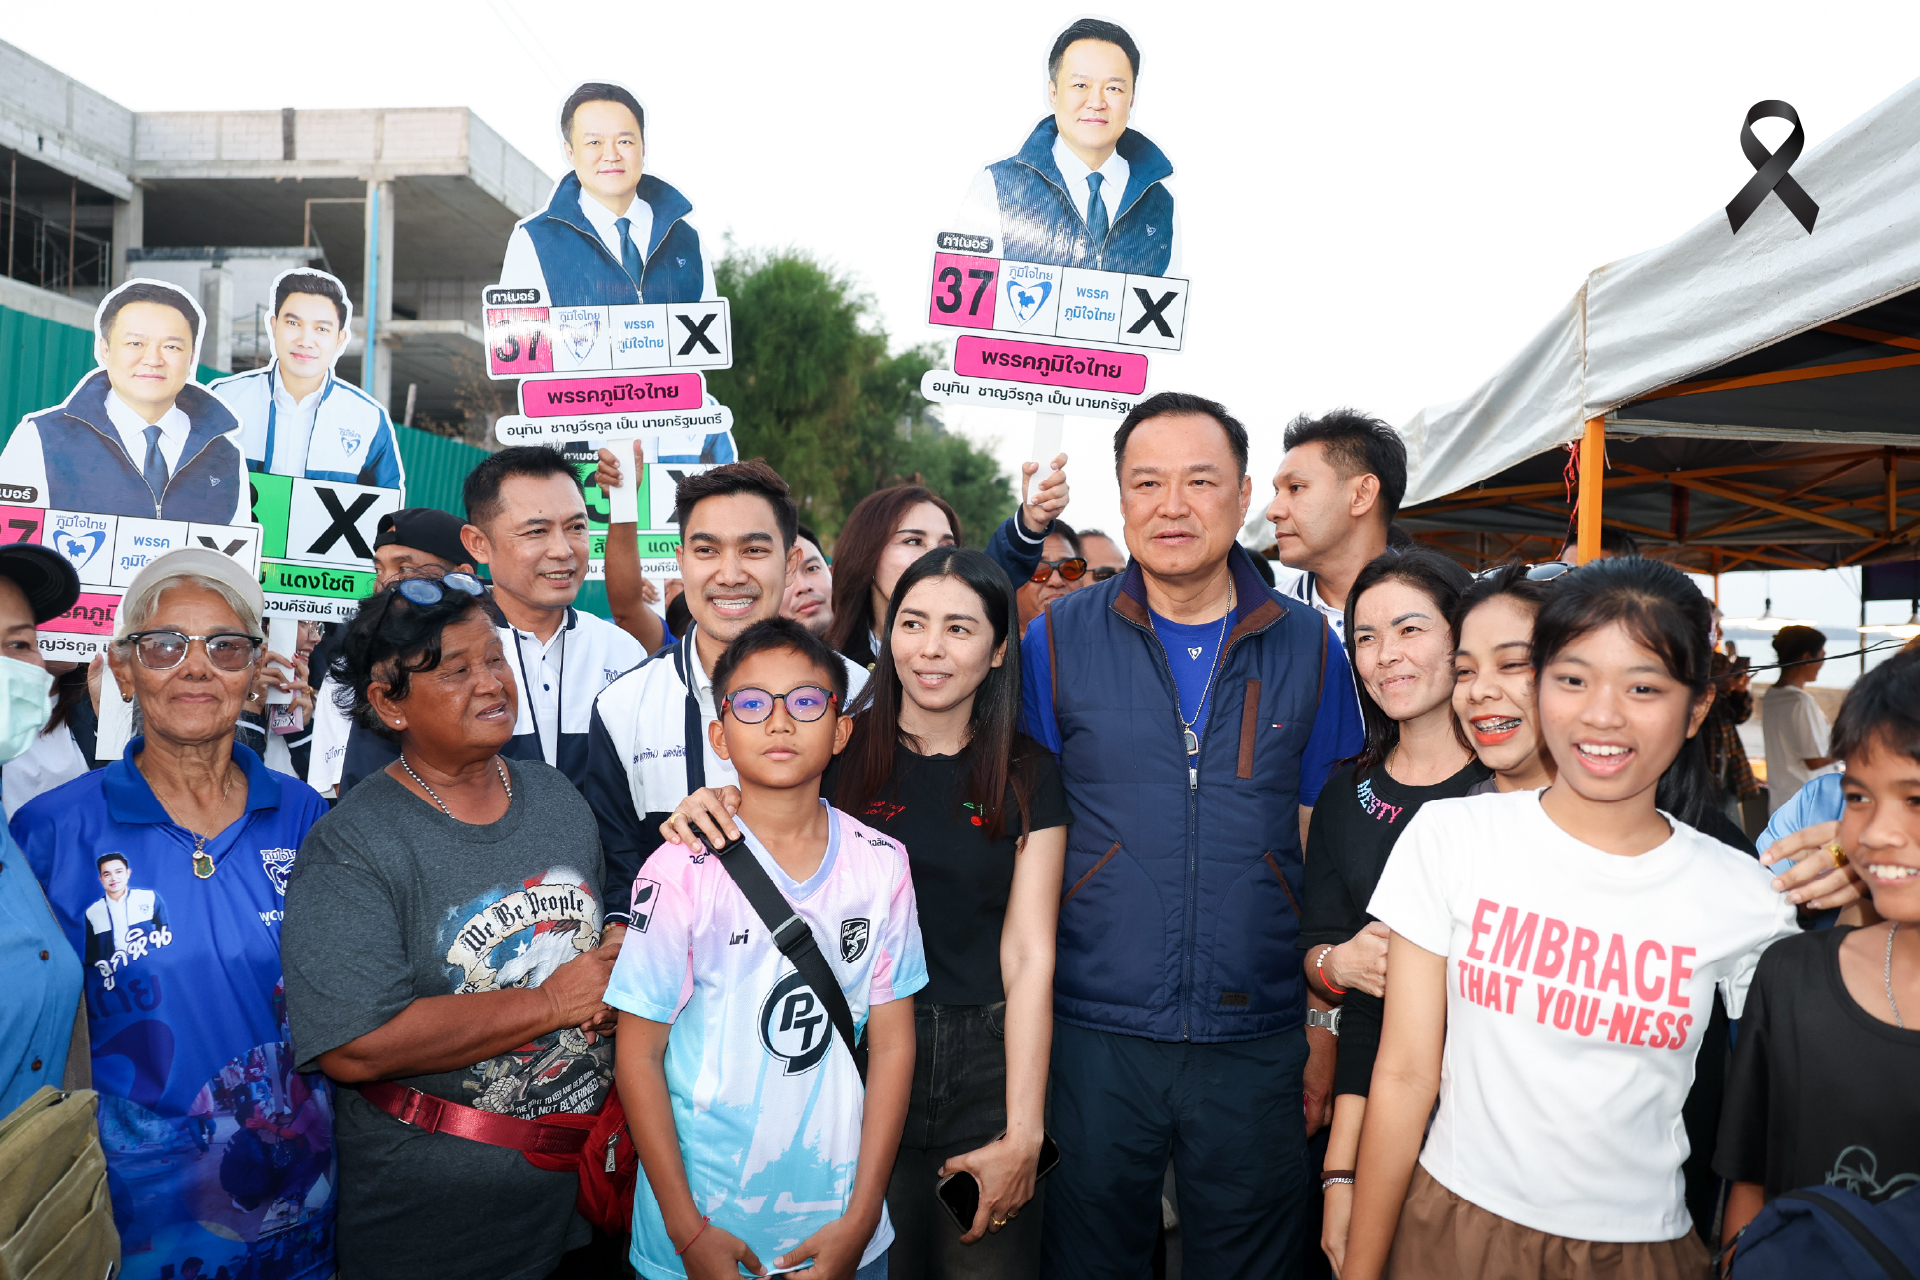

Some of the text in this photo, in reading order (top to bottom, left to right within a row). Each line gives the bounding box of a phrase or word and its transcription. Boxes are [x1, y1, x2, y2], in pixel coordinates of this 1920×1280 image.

[936, 266, 994, 316] 37
[1076, 286, 1109, 300] พรรค
[624, 320, 655, 329] พรรค
[1064, 305, 1116, 321] ภูมิใจไทย
[982, 350, 1122, 379] พรรคภูมิใจไทย
[547, 383, 679, 406] พรรคภูมิใจไทย
[932, 381, 970, 396] อนุทิน
[978, 386, 1044, 405] ชาญวีรกูล
[1048, 390, 1071, 405] เป็น
[506, 412, 722, 438] อนุทิน ชาญวีรกูล เป็น นายกรัฐมนตรี
[56, 515, 107, 531] ภูมิใจไทย
[134, 535, 170, 549] พรรค
[280, 572, 355, 592] แดงโชติ
[459, 890, 584, 958] We Be People
[1466, 898, 1696, 1008] EMBRACE
[1458, 960, 1693, 1050] THAT YOU-NESS
[538, 1105, 558, 1115] NOT
[560, 1099, 571, 1112] BE
